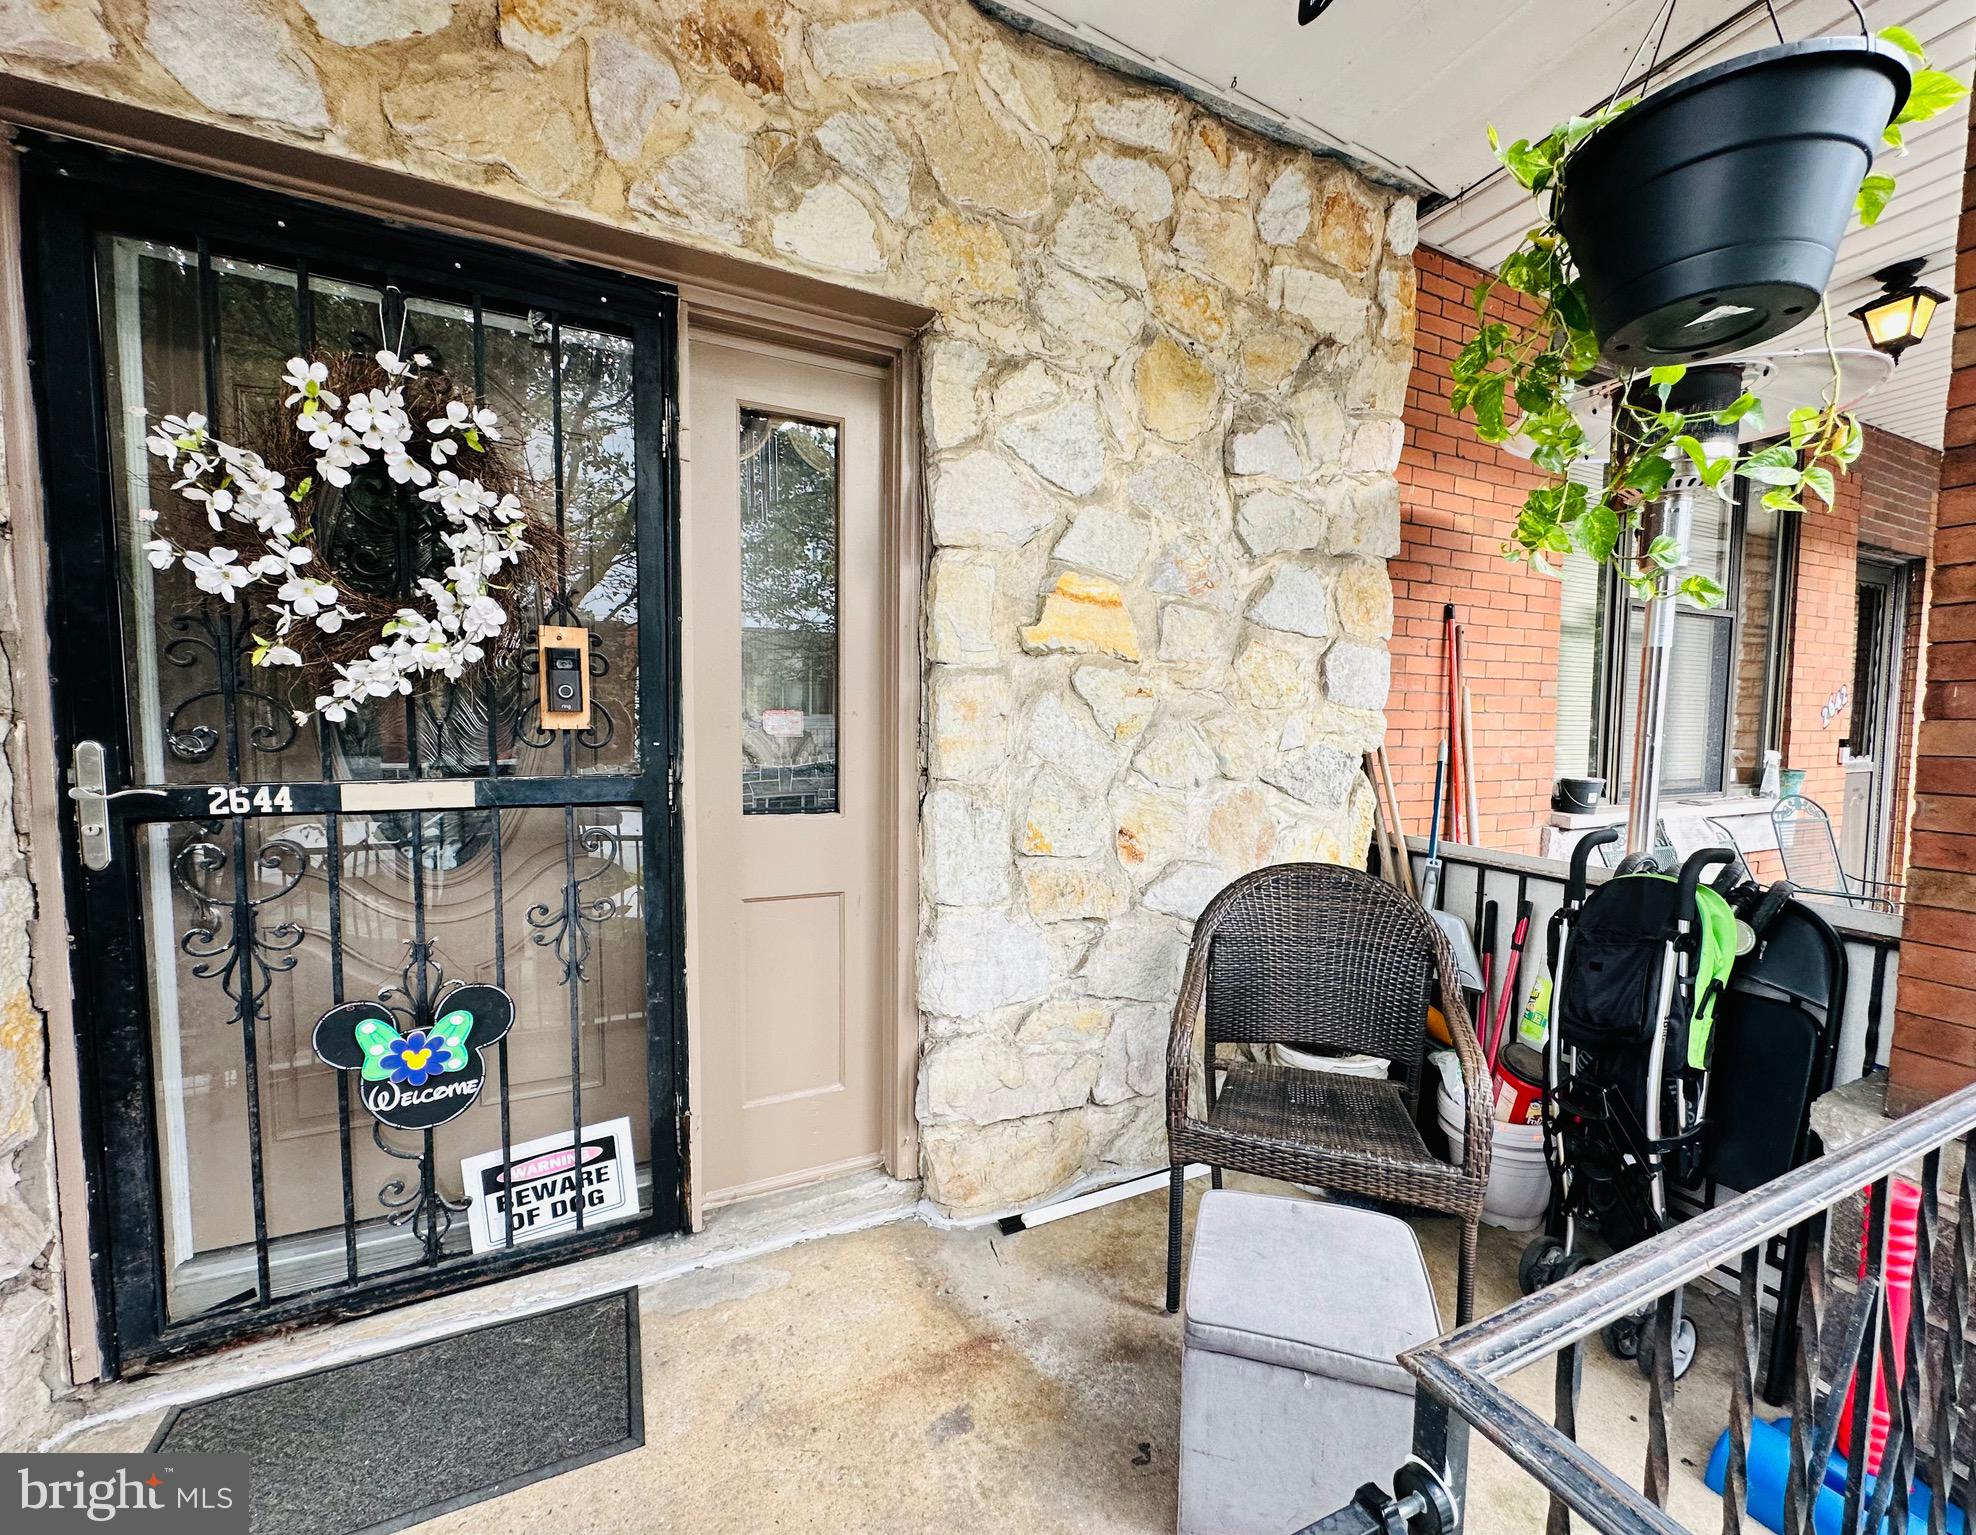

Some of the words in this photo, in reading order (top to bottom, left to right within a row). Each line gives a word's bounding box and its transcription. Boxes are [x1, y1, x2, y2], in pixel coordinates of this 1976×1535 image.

[207, 785, 293, 815] 2644
[511, 1149, 590, 1179] WARNING
[496, 1165, 610, 1213] BEWARE
[508, 1206, 540, 1231] OF
[551, 1189, 605, 1219] DOG
